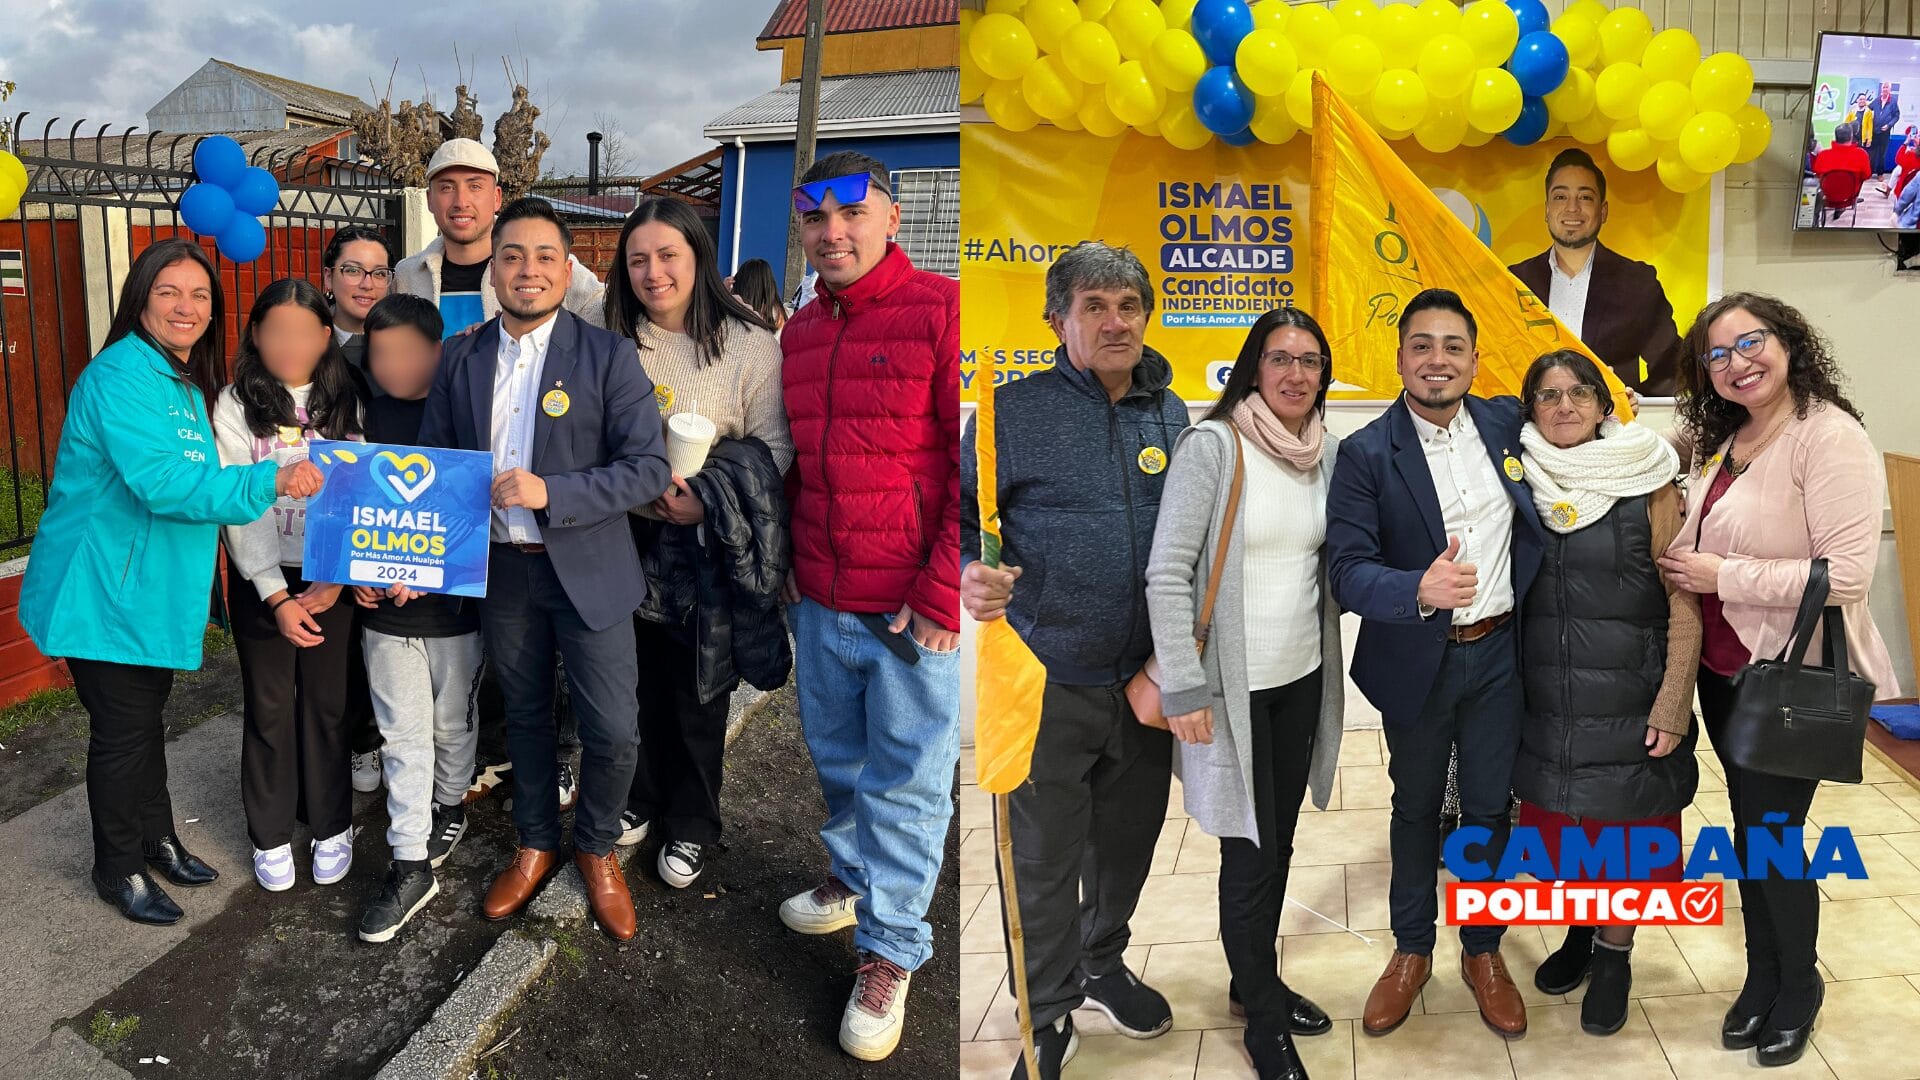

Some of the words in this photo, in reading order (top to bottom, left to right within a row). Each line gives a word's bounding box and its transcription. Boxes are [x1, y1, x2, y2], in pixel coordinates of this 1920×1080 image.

[1158, 181, 1292, 210] ISMAEL
[1160, 214, 1293, 243] OLMOS
[1168, 248, 1287, 270] ALCALDE
[1161, 274, 1294, 297] Candidato
[1162, 298, 1295, 311] INDEPENDIENTE
[1166, 315, 1184, 324] Por
[1186, 314, 1206, 324] Más
[1208, 315, 1237, 325] Amor
[1238, 315, 1247, 324] A
[1013, 350, 1056, 365] SEG
[353, 506, 447, 533] ISMAEL
[351, 528, 446, 556] OLMOS
[351, 550, 364, 558] Por
[365, 551, 381, 560] Más
[382, 553, 404, 561] Amor
[412, 556, 445, 567] Hualpén
[377, 566, 418, 581] 2024
